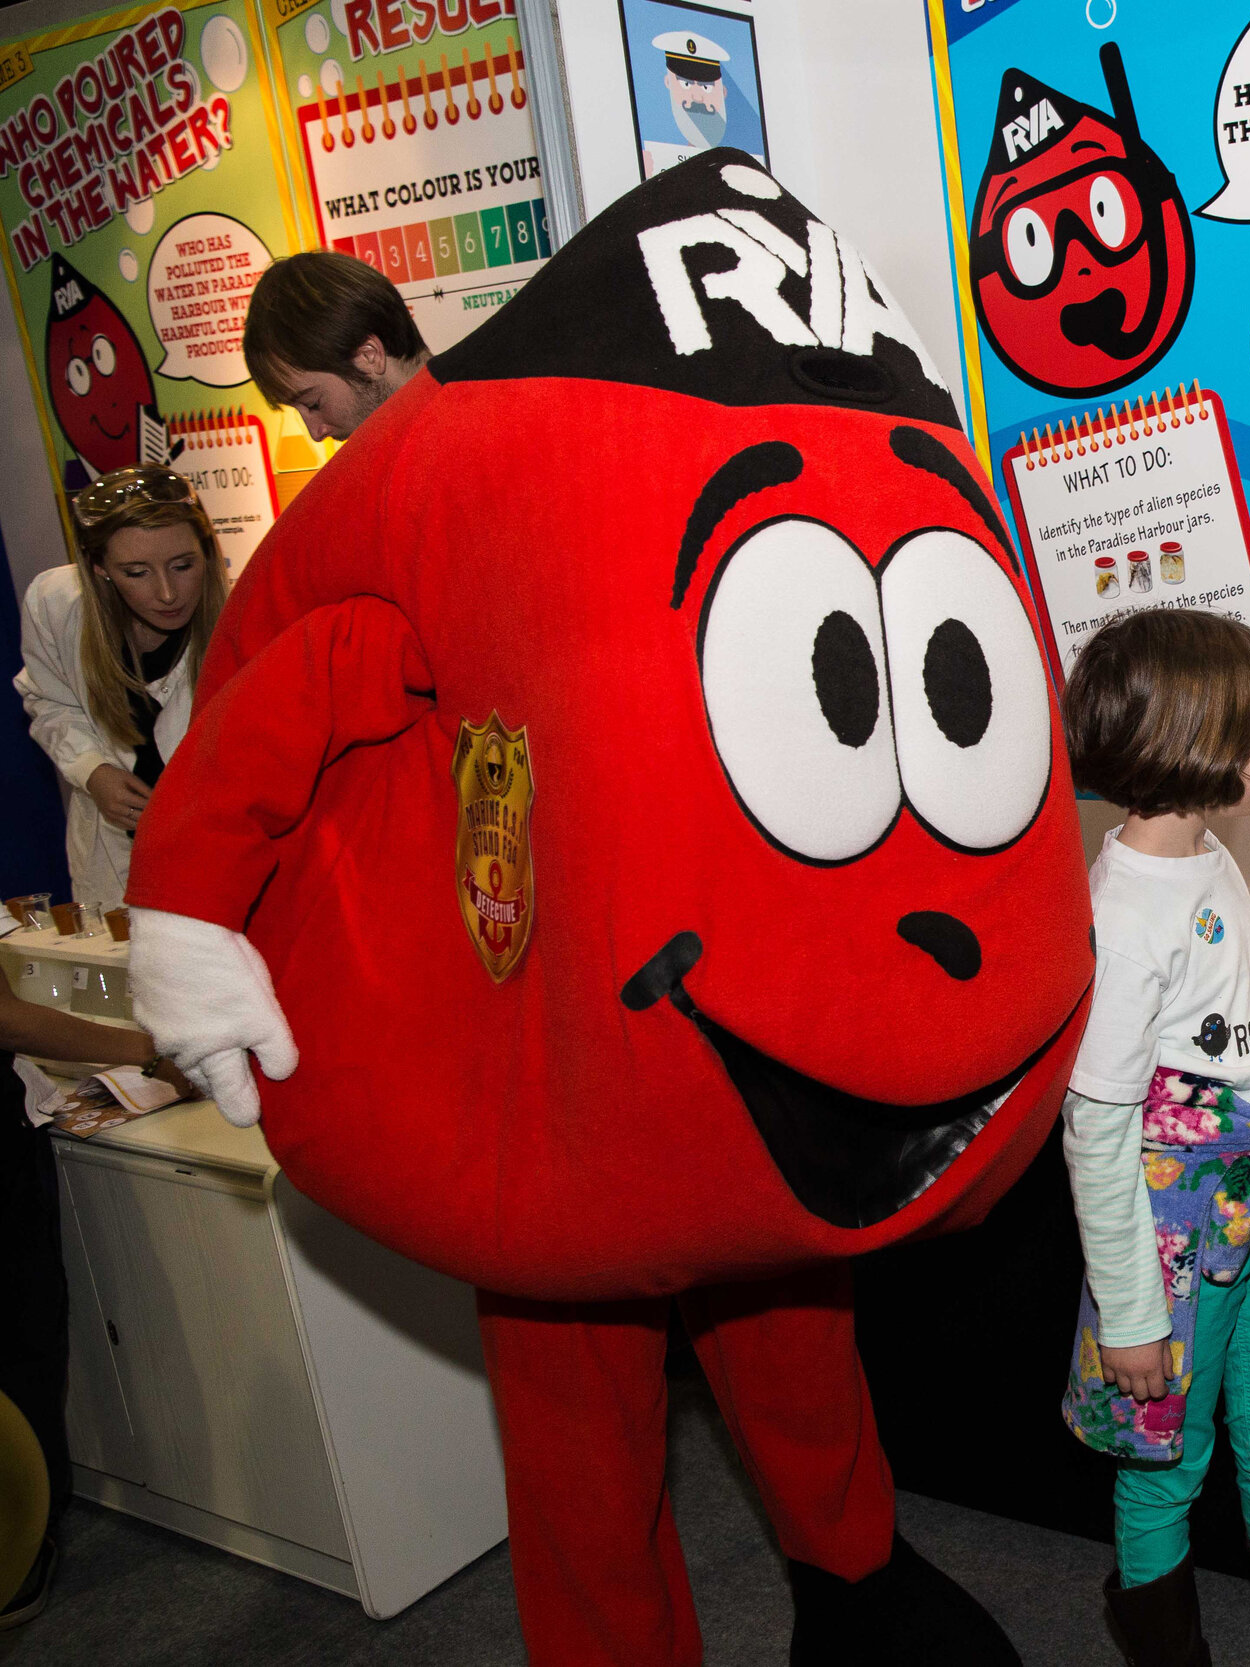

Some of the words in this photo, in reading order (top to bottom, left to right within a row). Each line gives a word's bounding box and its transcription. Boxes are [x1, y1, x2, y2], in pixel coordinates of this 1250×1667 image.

[0, 98, 58, 176] WHO
[55, 9, 184, 129] POURED
[19, 63, 192, 209] CHEMICALS
[1002, 97, 1064, 163] RYA
[11, 213, 50, 270] IN
[45, 174, 112, 245] THE
[108, 97, 231, 211] WATER?
[325, 190, 379, 220] WHAT
[384, 173, 462, 208] COLOUR
[464, 169, 482, 192] IS
[486, 156, 541, 188] YOUR
[175, 240, 205, 257] WHO
[206, 234, 232, 252] HAS
[364, 250, 376, 267] 2
[389, 246, 400, 268] 3
[415, 241, 427, 262] 4
[439, 236, 450, 259] 5
[464, 231, 476, 254] 6
[490, 226, 501, 249] 7
[516, 220, 529, 244] 8
[165, 256, 225, 280] POLLUTED
[226, 251, 251, 269] THE
[53, 279, 85, 316] RYA
[154, 283, 195, 303] WATER
[196, 280, 210, 296] IN
[170, 299, 228, 321] HARBOUR
[637, 207, 950, 391] RYA
[161, 321, 216, 342] HARMFUL
[212, 468, 229, 489] TO
[1063, 463, 1110, 493] WHAT
[1115, 455, 1137, 478] TO
[1142, 446, 1173, 472] DO:
[1039, 519, 1082, 541] Identify
[1084, 513, 1103, 529] the
[1105, 506, 1131, 527] type
[1133, 499, 1144, 516] of
[1146, 495, 1174, 513] alien
[1175, 482, 1221, 509] species
[1056, 549, 1067, 562] in
[1068, 543, 1087, 559] the
[1088, 529, 1136, 554] Paradise
[1138, 517, 1185, 541] Harbour
[1185, 511, 1215, 534] jars.
[1062, 621, 1088, 635] Then
[1176, 593, 1197, 608] the
[1199, 583, 1244, 607] species
[465, 798, 500, 831] MARINE
[472, 830, 499, 857] STAND
[476, 889, 516, 923] DETECTIVE
[25, 963, 34, 975] 3
